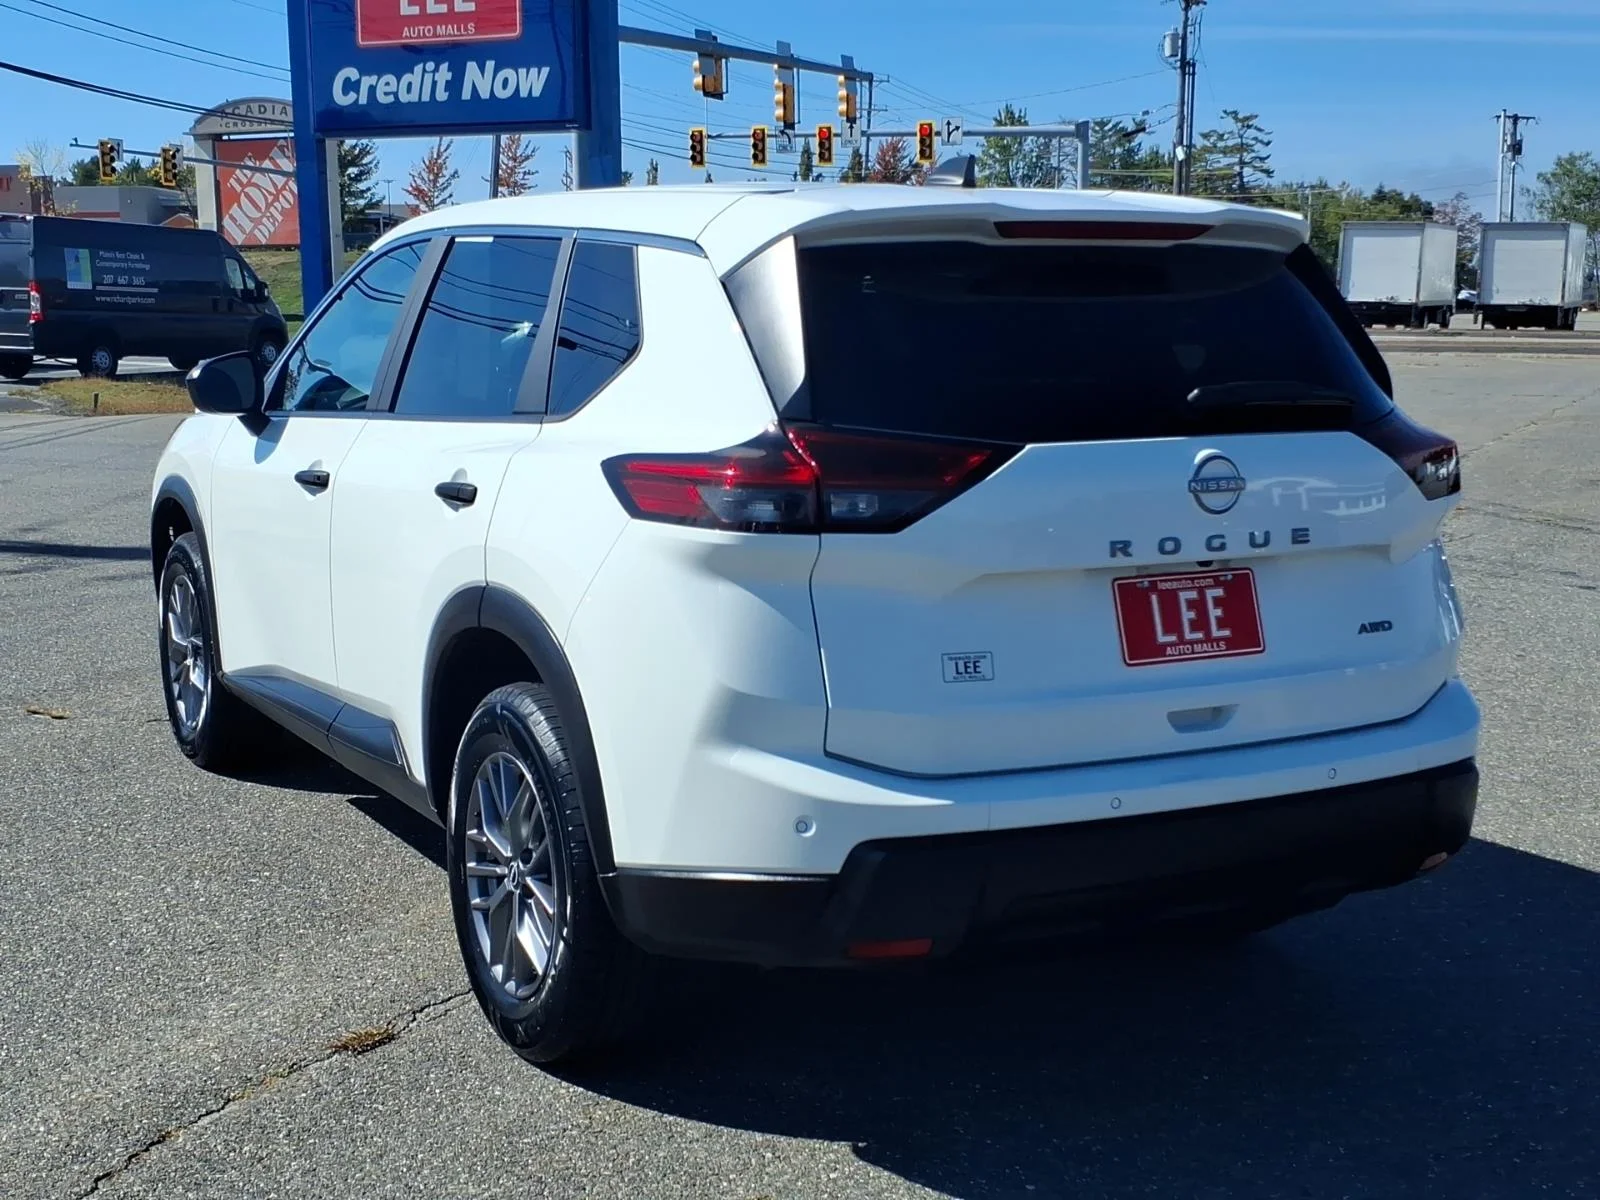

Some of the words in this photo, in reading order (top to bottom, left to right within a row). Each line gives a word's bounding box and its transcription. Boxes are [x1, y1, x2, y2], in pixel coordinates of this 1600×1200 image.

[402, 25, 434, 38] AUTO
[436, 22, 476, 36] MALLS
[332, 61, 453, 106] Credit
[461, 59, 550, 100] Now
[227, 152, 260, 193] THE
[1190, 480, 1245, 491] NISSAN
[1109, 527, 1311, 558] ROGUE
[1157, 578, 1215, 590] leeauto.com
[1150, 587, 1233, 644] LEE
[1357, 620, 1393, 635] AWD
[1165, 644, 1193, 656] AUTO
[1193, 641, 1227, 653] MALLS
[954, 660, 982, 675] LEE
